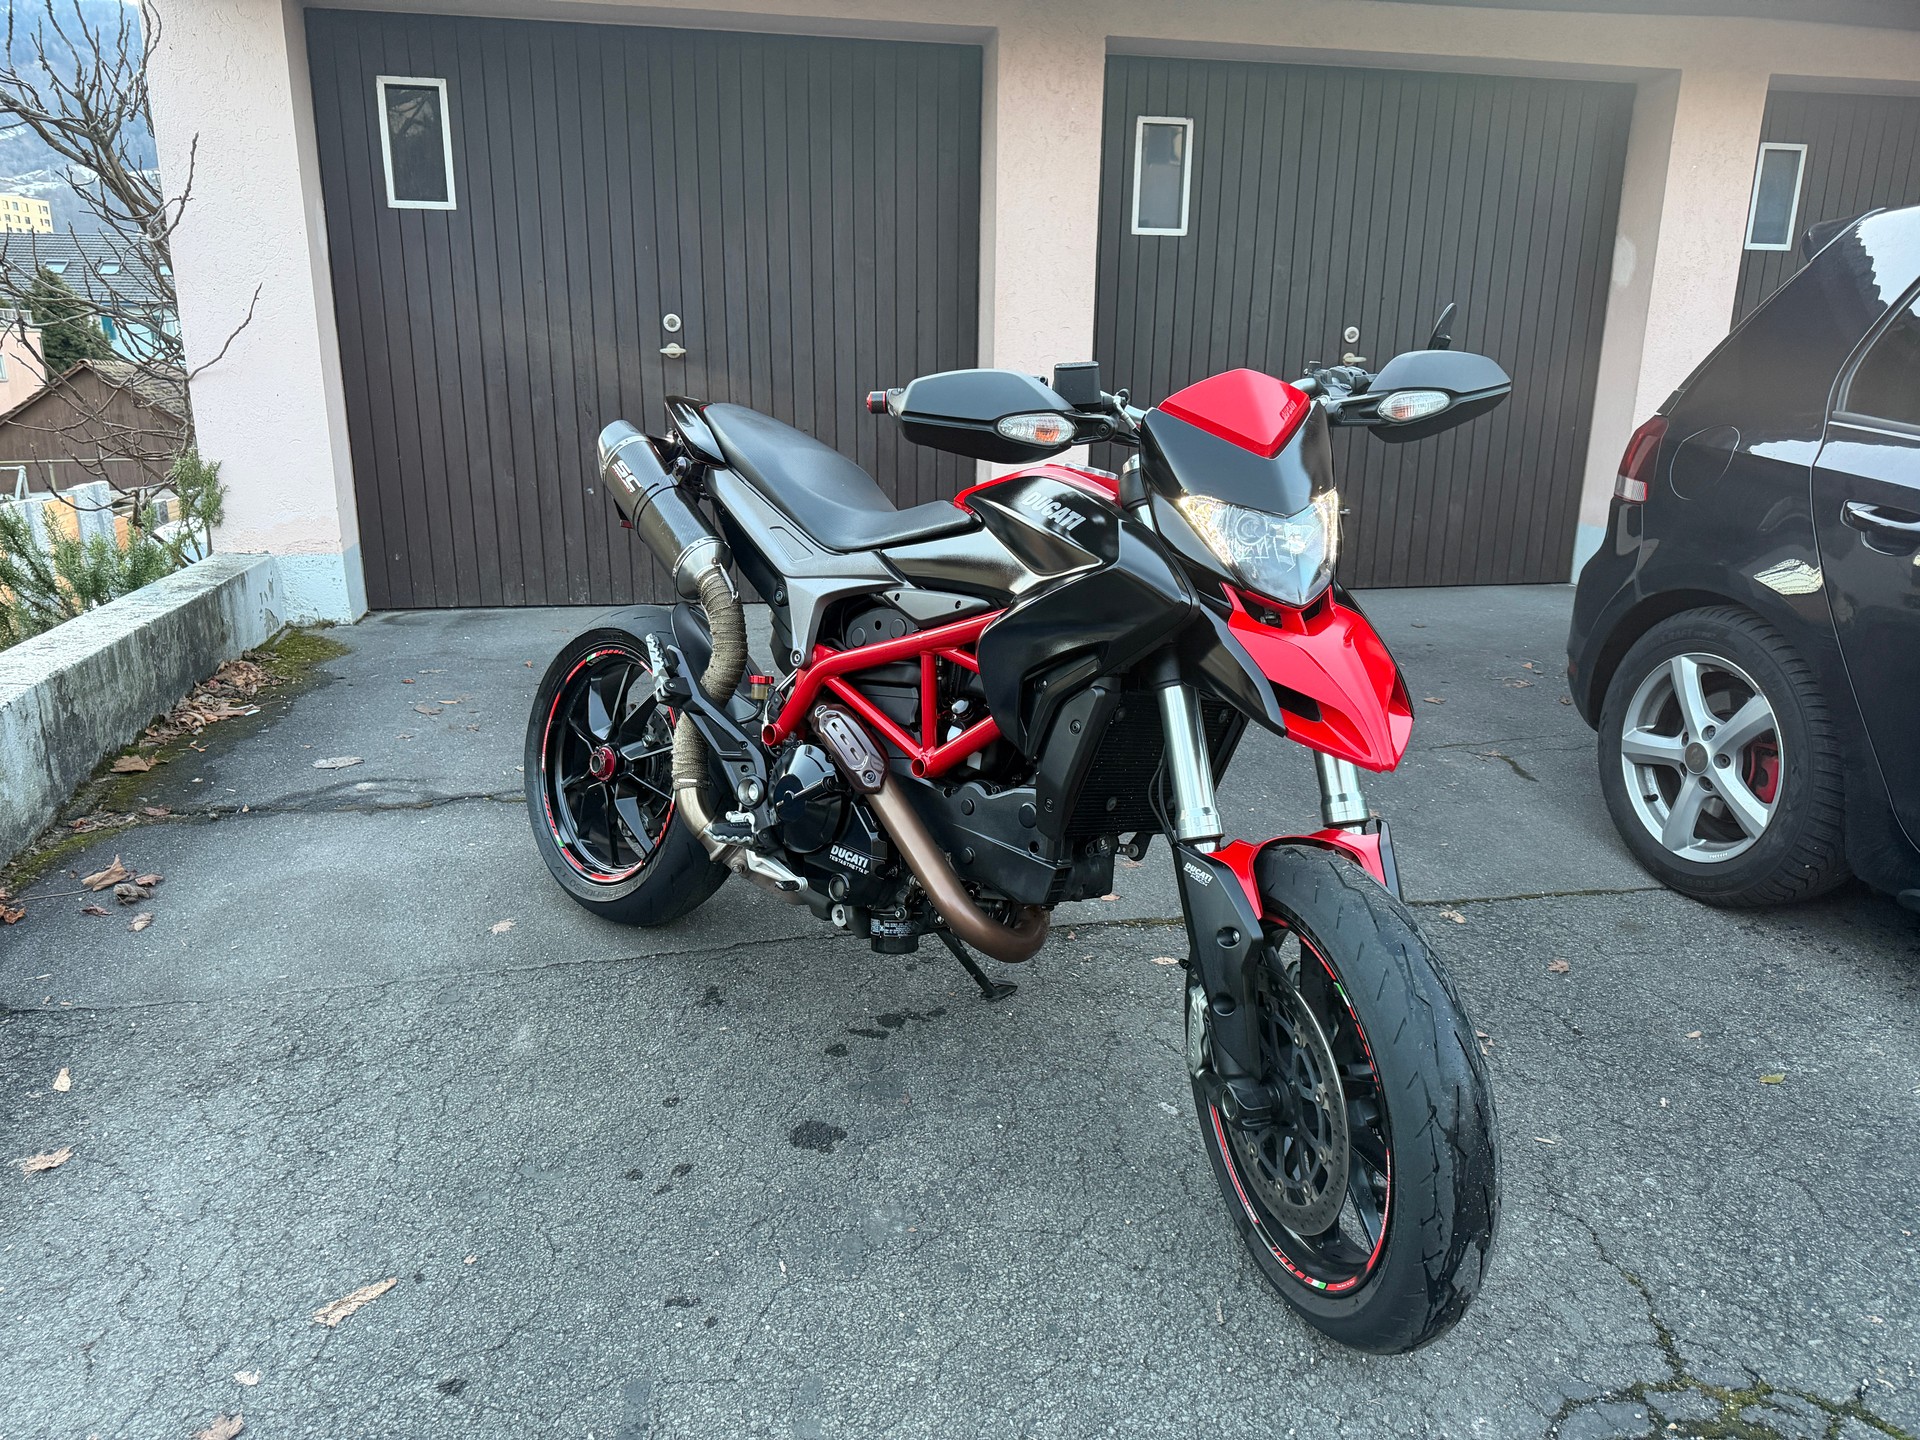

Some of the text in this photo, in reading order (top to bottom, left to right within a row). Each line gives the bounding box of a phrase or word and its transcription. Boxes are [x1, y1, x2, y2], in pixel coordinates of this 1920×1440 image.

[1021, 491, 1087, 531] DUCATI
[830, 845, 869, 868] DUCATI
[1184, 862, 1213, 882] DUCATI
